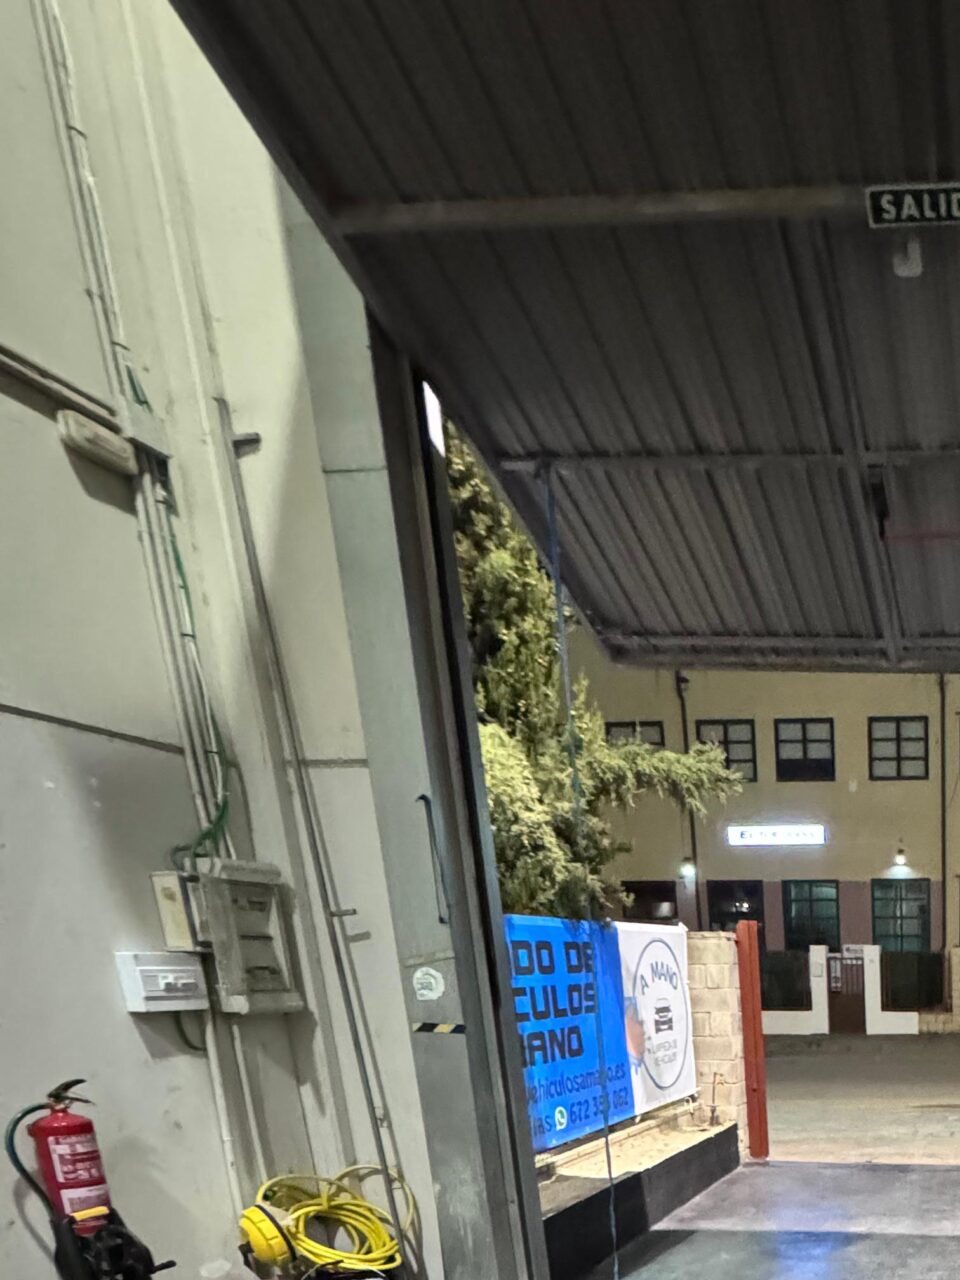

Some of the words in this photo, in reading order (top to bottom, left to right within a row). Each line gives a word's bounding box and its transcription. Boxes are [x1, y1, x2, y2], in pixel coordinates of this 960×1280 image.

[640, 974, 649, 995] A
[650, 961, 678, 990] MANO
[570, 1099, 590, 1124] 672
